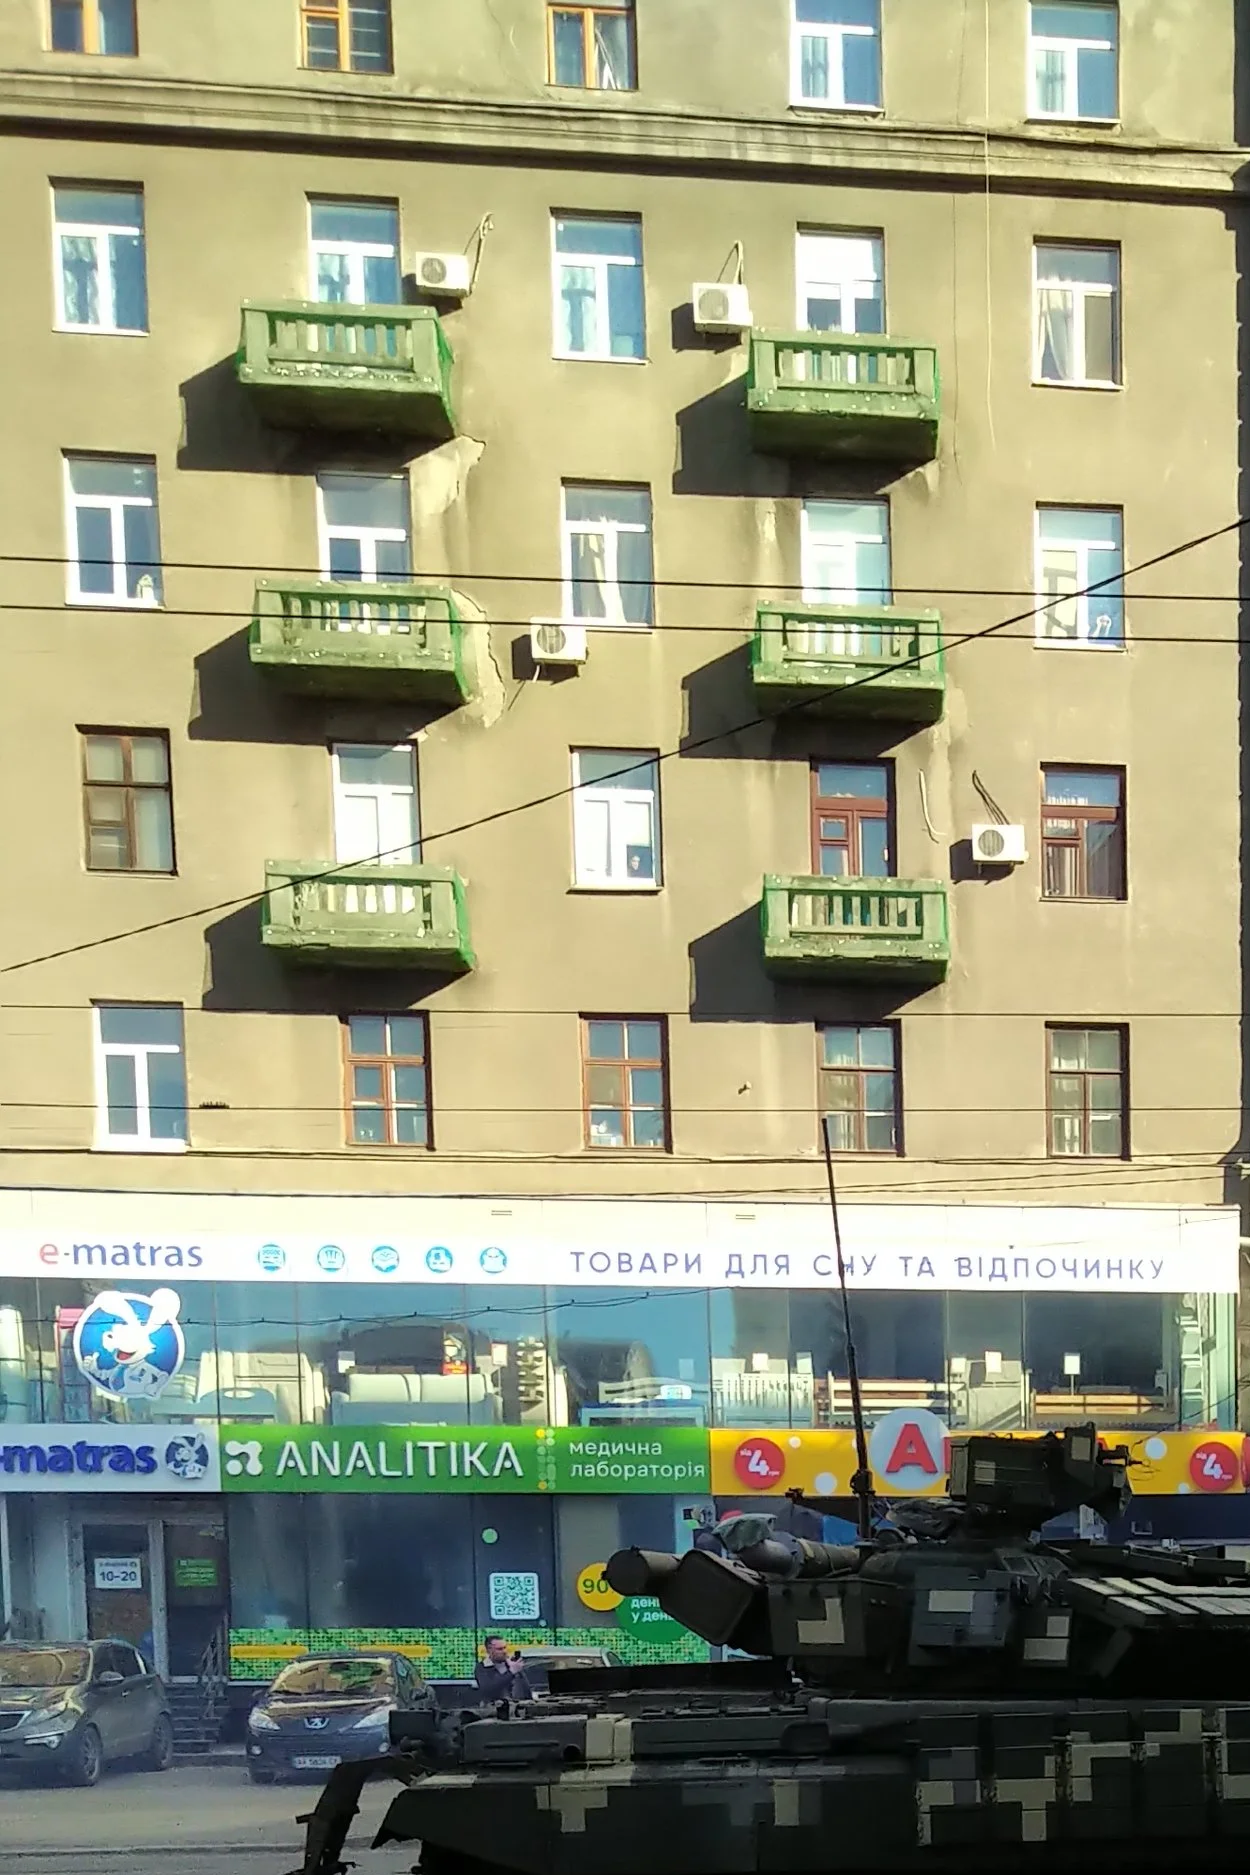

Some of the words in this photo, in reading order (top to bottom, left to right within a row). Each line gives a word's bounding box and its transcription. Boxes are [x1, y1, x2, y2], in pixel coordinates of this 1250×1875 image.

[39, 1242, 203, 1267] e-matras
[570, 1251, 702, 1274] ТОВАРИ
[725, 1253, 790, 1279] ДЛЯ
[813, 1254, 876, 1276] СНУ
[899, 1256, 935, 1277] ТА
[955, 1257, 1164, 1281] ВІДПОЧИНКУ
[275, 1440, 524, 1477] ANALITIKA
[569, 1442, 662, 1457] медична
[570, 1461, 705, 1481] лабораторія
[748, 1449, 770, 1476] 4
[1203, 1453, 1223, 1479] 4
[99, 1570, 138, 1582] 10-20
